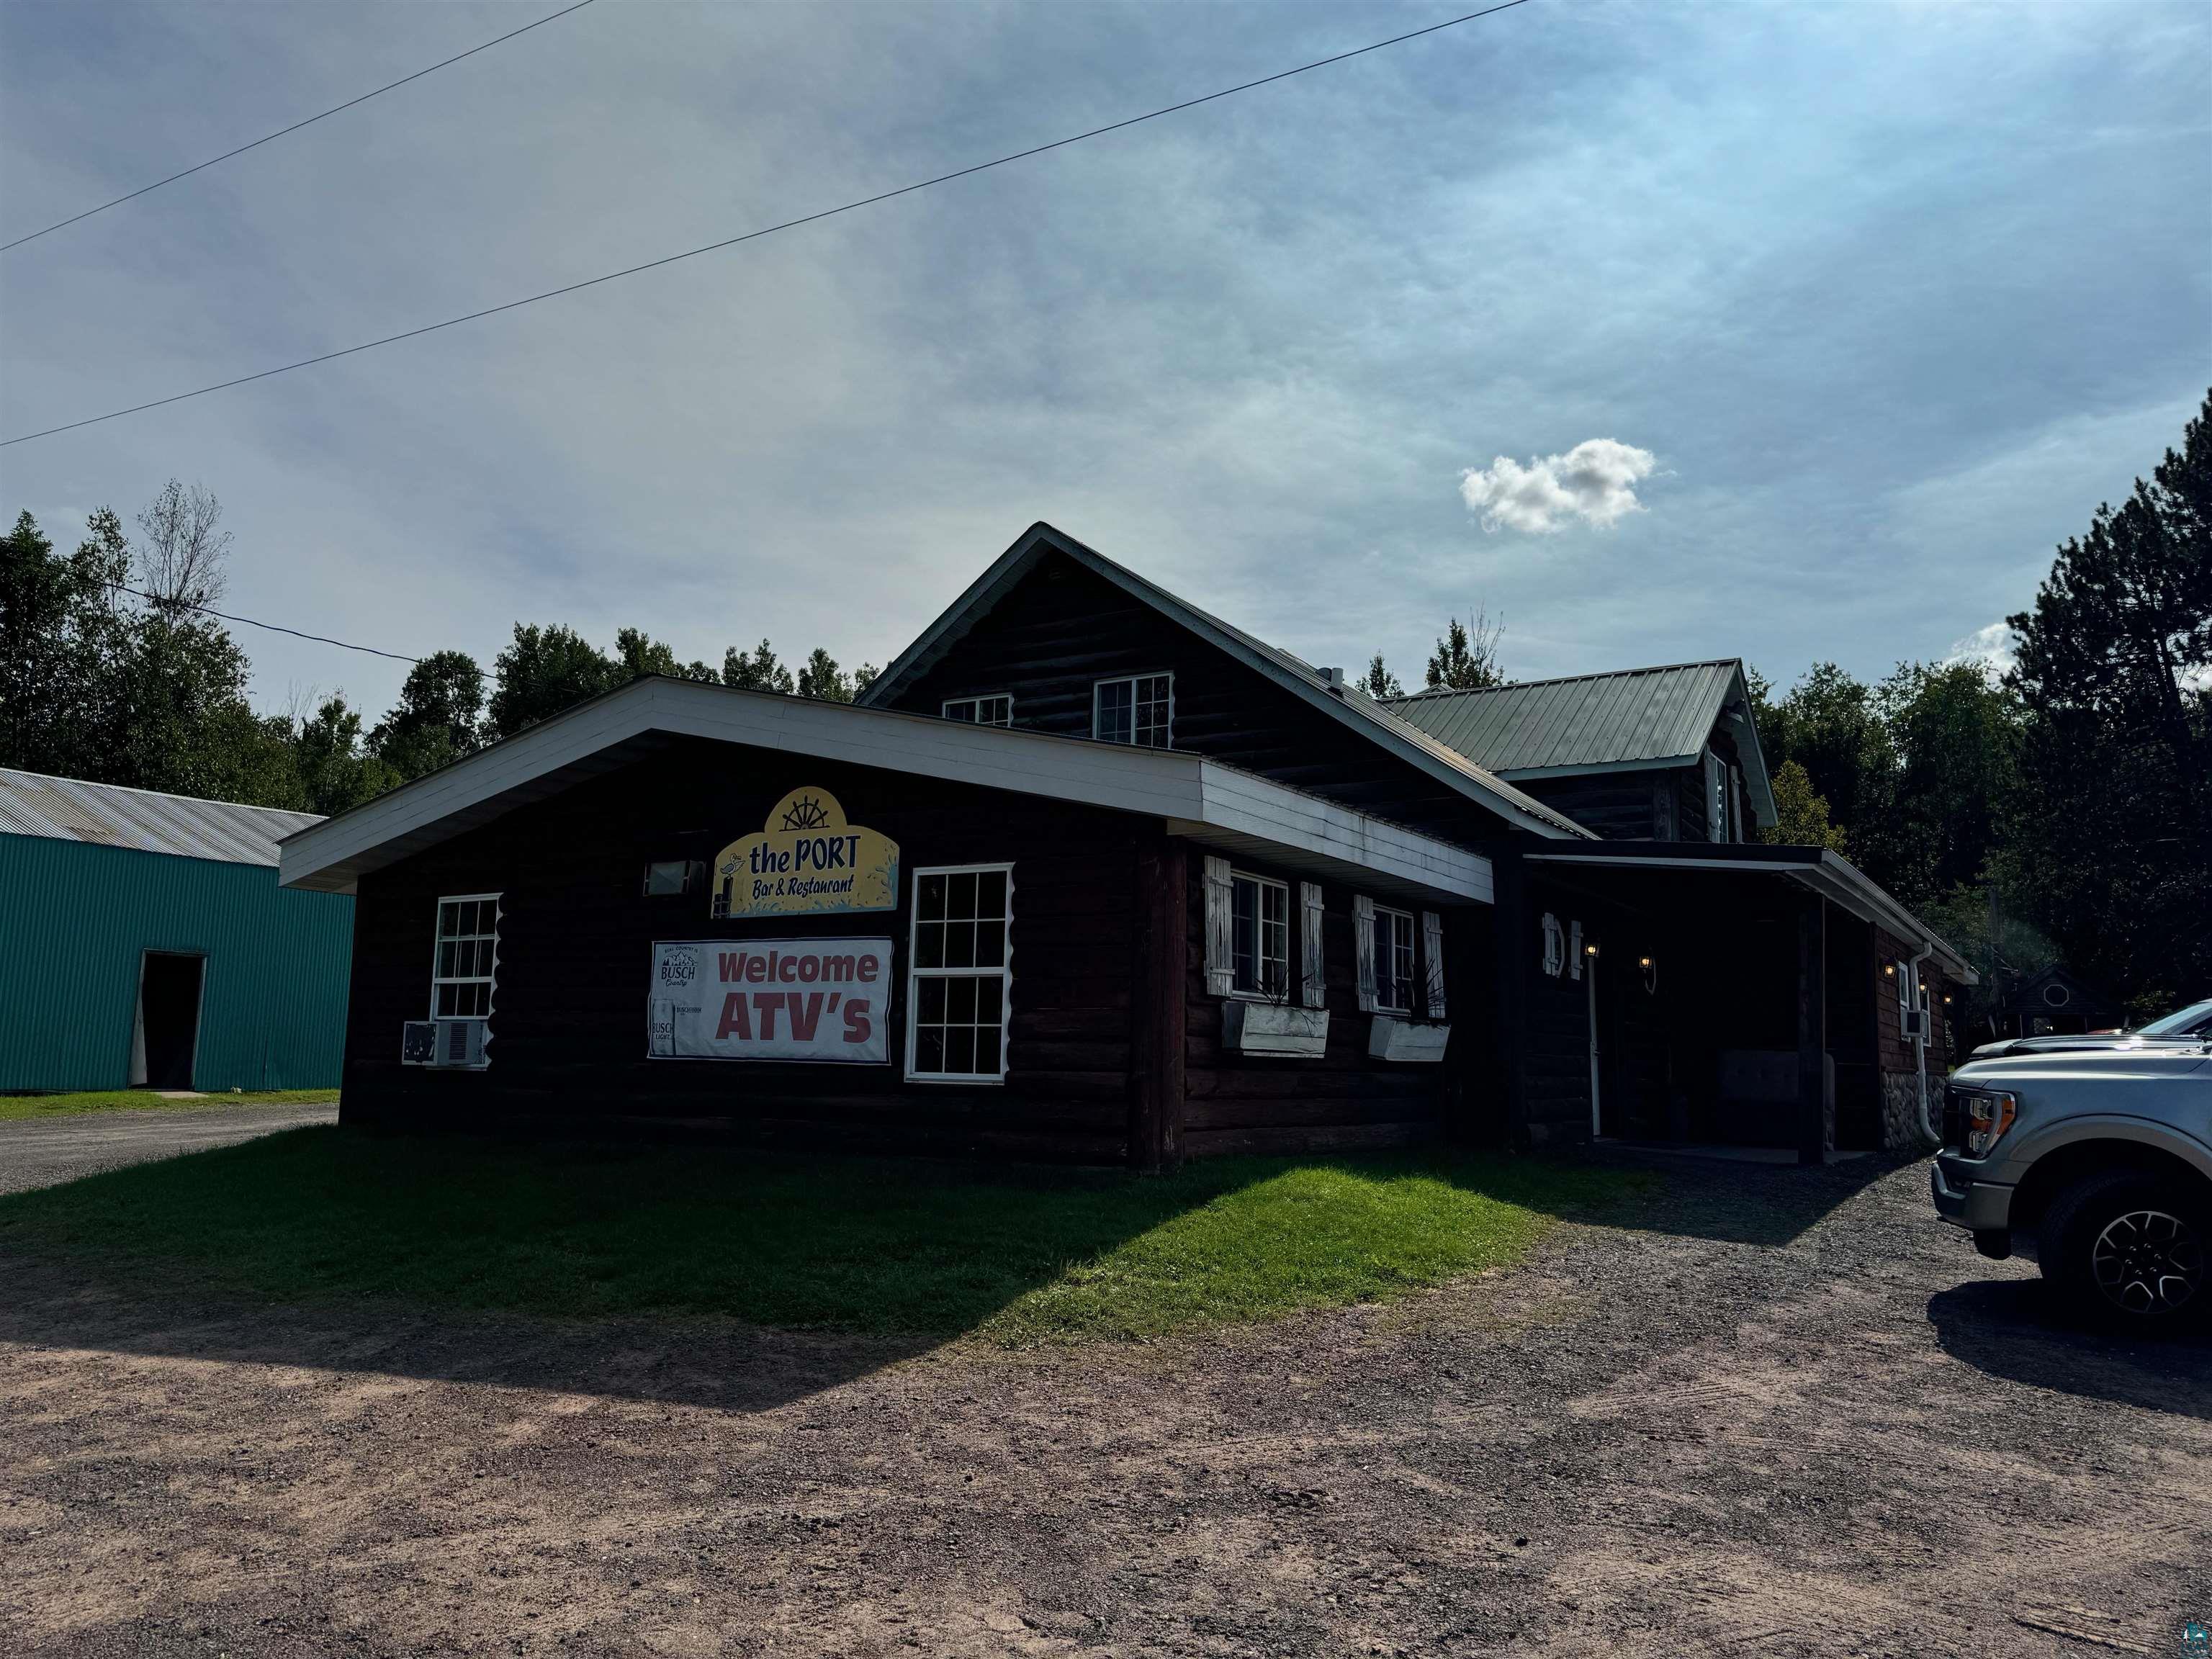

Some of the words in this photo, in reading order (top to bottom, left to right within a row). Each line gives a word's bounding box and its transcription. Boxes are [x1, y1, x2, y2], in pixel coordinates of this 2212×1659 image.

[749, 842, 790, 874] the
[794, 835, 861, 871] PORT
[752, 878, 773, 899] Bar
[775, 878, 785, 896] &
[787, 874, 855, 898] Restaurant
[661, 967, 696, 980] BUSCH
[718, 950, 879, 984] Welcome
[715, 992, 872, 1043] ATV's
